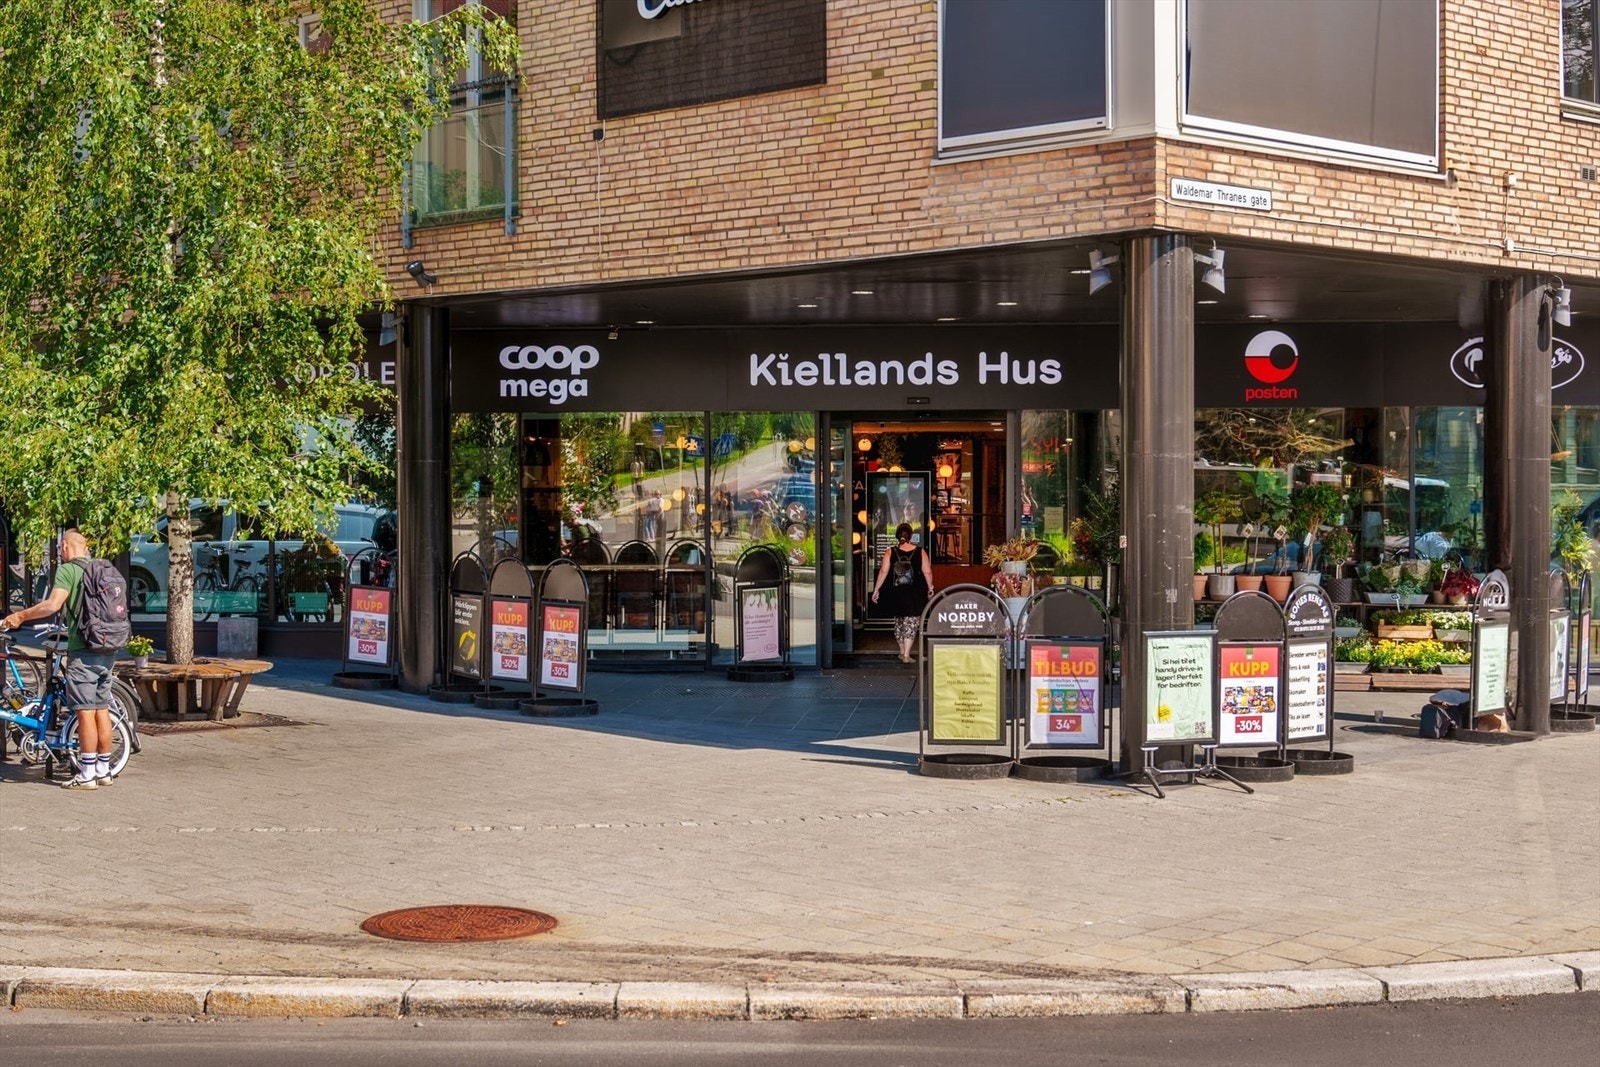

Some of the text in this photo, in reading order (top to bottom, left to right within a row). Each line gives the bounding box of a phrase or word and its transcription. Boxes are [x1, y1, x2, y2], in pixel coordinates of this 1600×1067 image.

[1175, 184, 1268, 207] Waldemar Thranes gate
[499, 345, 600, 375] coop
[750, 351, 1062, 386] Kiellands Hus
[500, 378, 588, 405] mega
[1245, 386, 1298, 402] posten
[356, 599, 383, 612] KUPP
[498, 612, 523, 626] KUPP
[938, 612, 994, 623] NORDBY
[549, 618, 575, 632] KUPP
[359, 643, 376, 654] -30%
[502, 658, 518, 670] -30%
[1035, 661, 1097, 676] TILBUD
[1229, 661, 1270, 677] KUPP
[552, 666, 569, 677] -30%
[1169, 681, 1202, 689] bedrifter.
[1236, 719, 1262, 731] -30%
